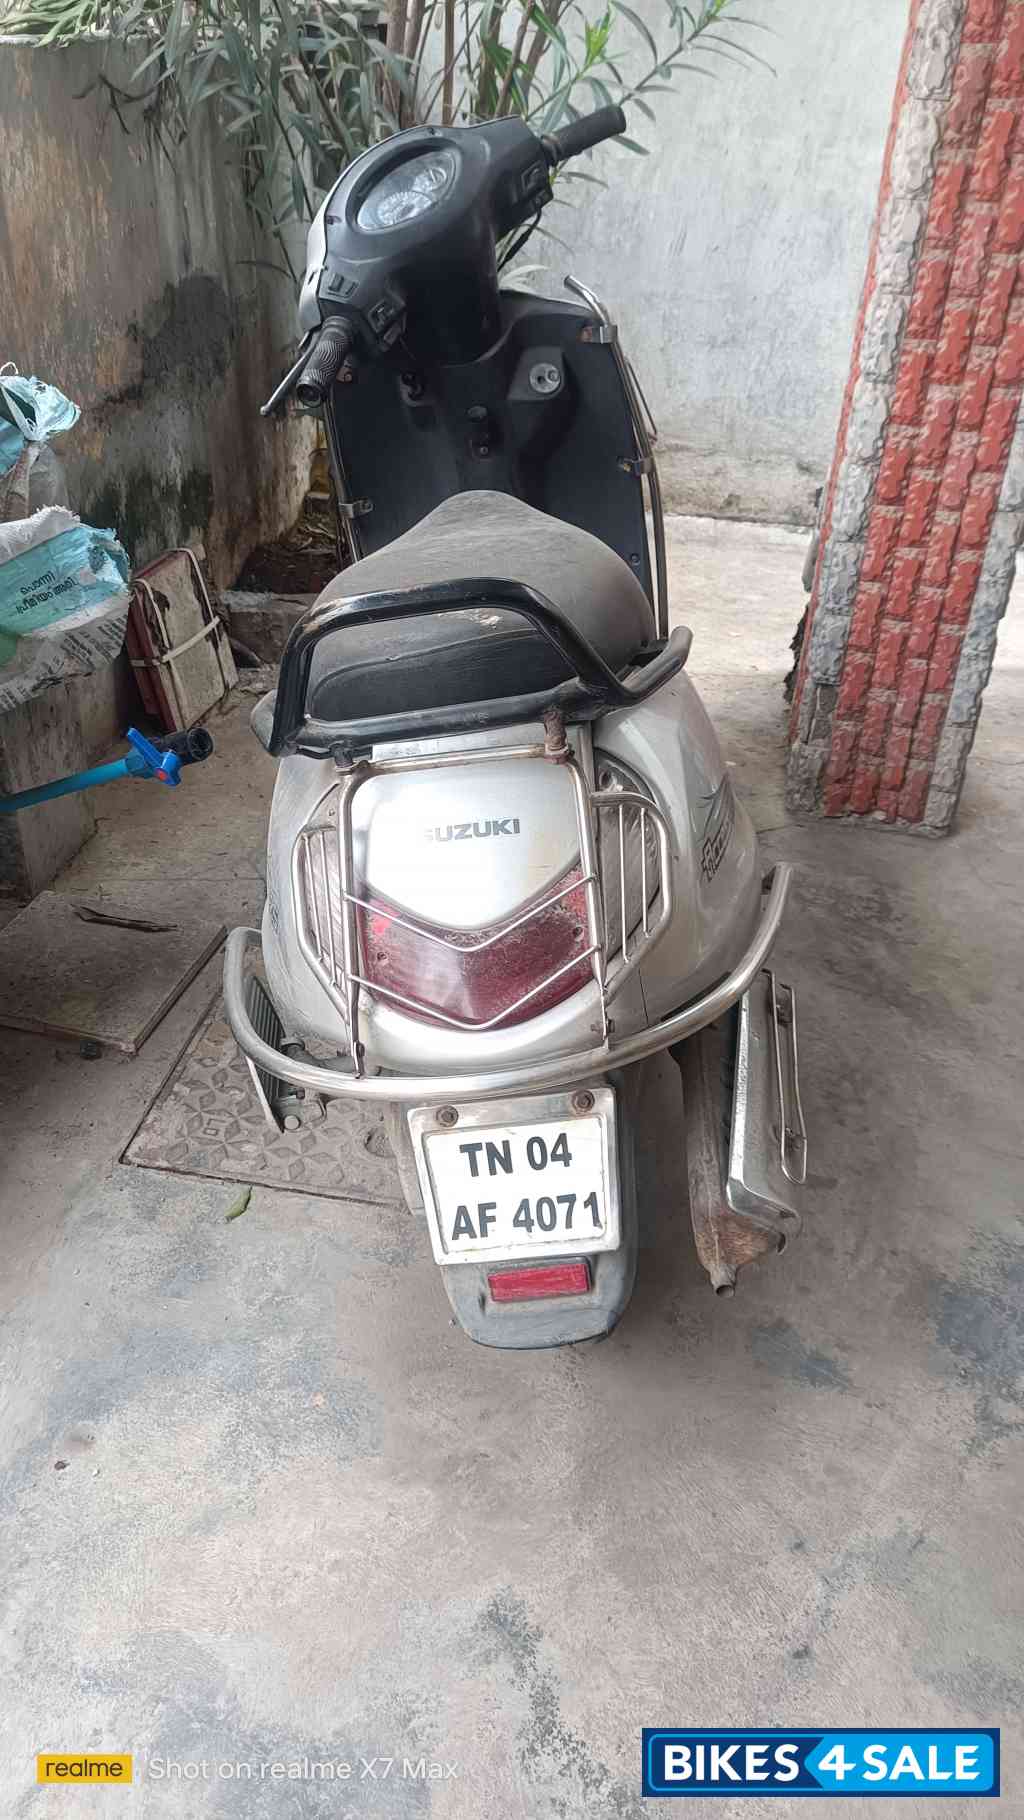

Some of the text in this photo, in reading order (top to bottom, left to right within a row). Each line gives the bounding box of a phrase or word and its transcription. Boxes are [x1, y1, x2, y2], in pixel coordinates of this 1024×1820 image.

[459, 1133, 573, 1177] TN 04
[451, 1191, 602, 1240] AF 4071
